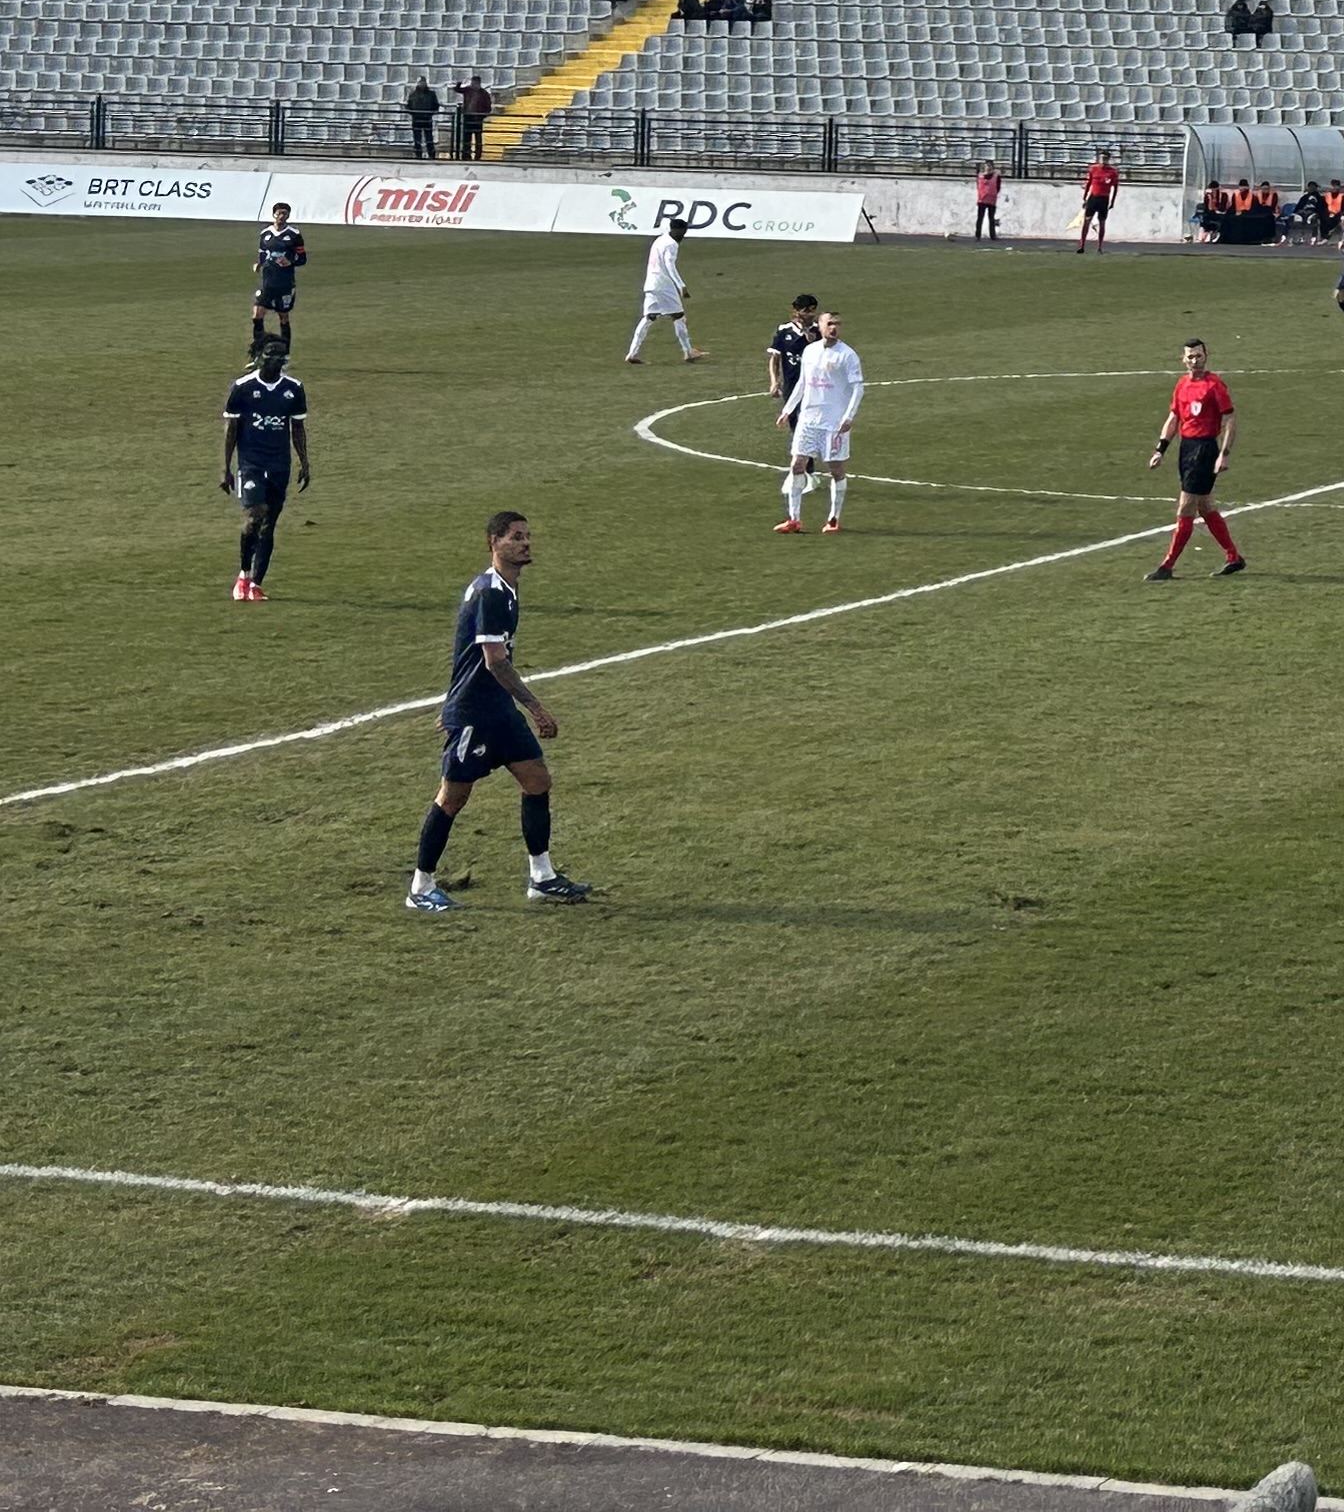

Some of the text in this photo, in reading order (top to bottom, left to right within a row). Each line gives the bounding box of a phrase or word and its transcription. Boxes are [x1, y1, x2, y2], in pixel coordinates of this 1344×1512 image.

[87, 178, 213, 199] BRT CLASS
[375, 182, 481, 213] misli
[752, 220, 815, 232] GROUP
